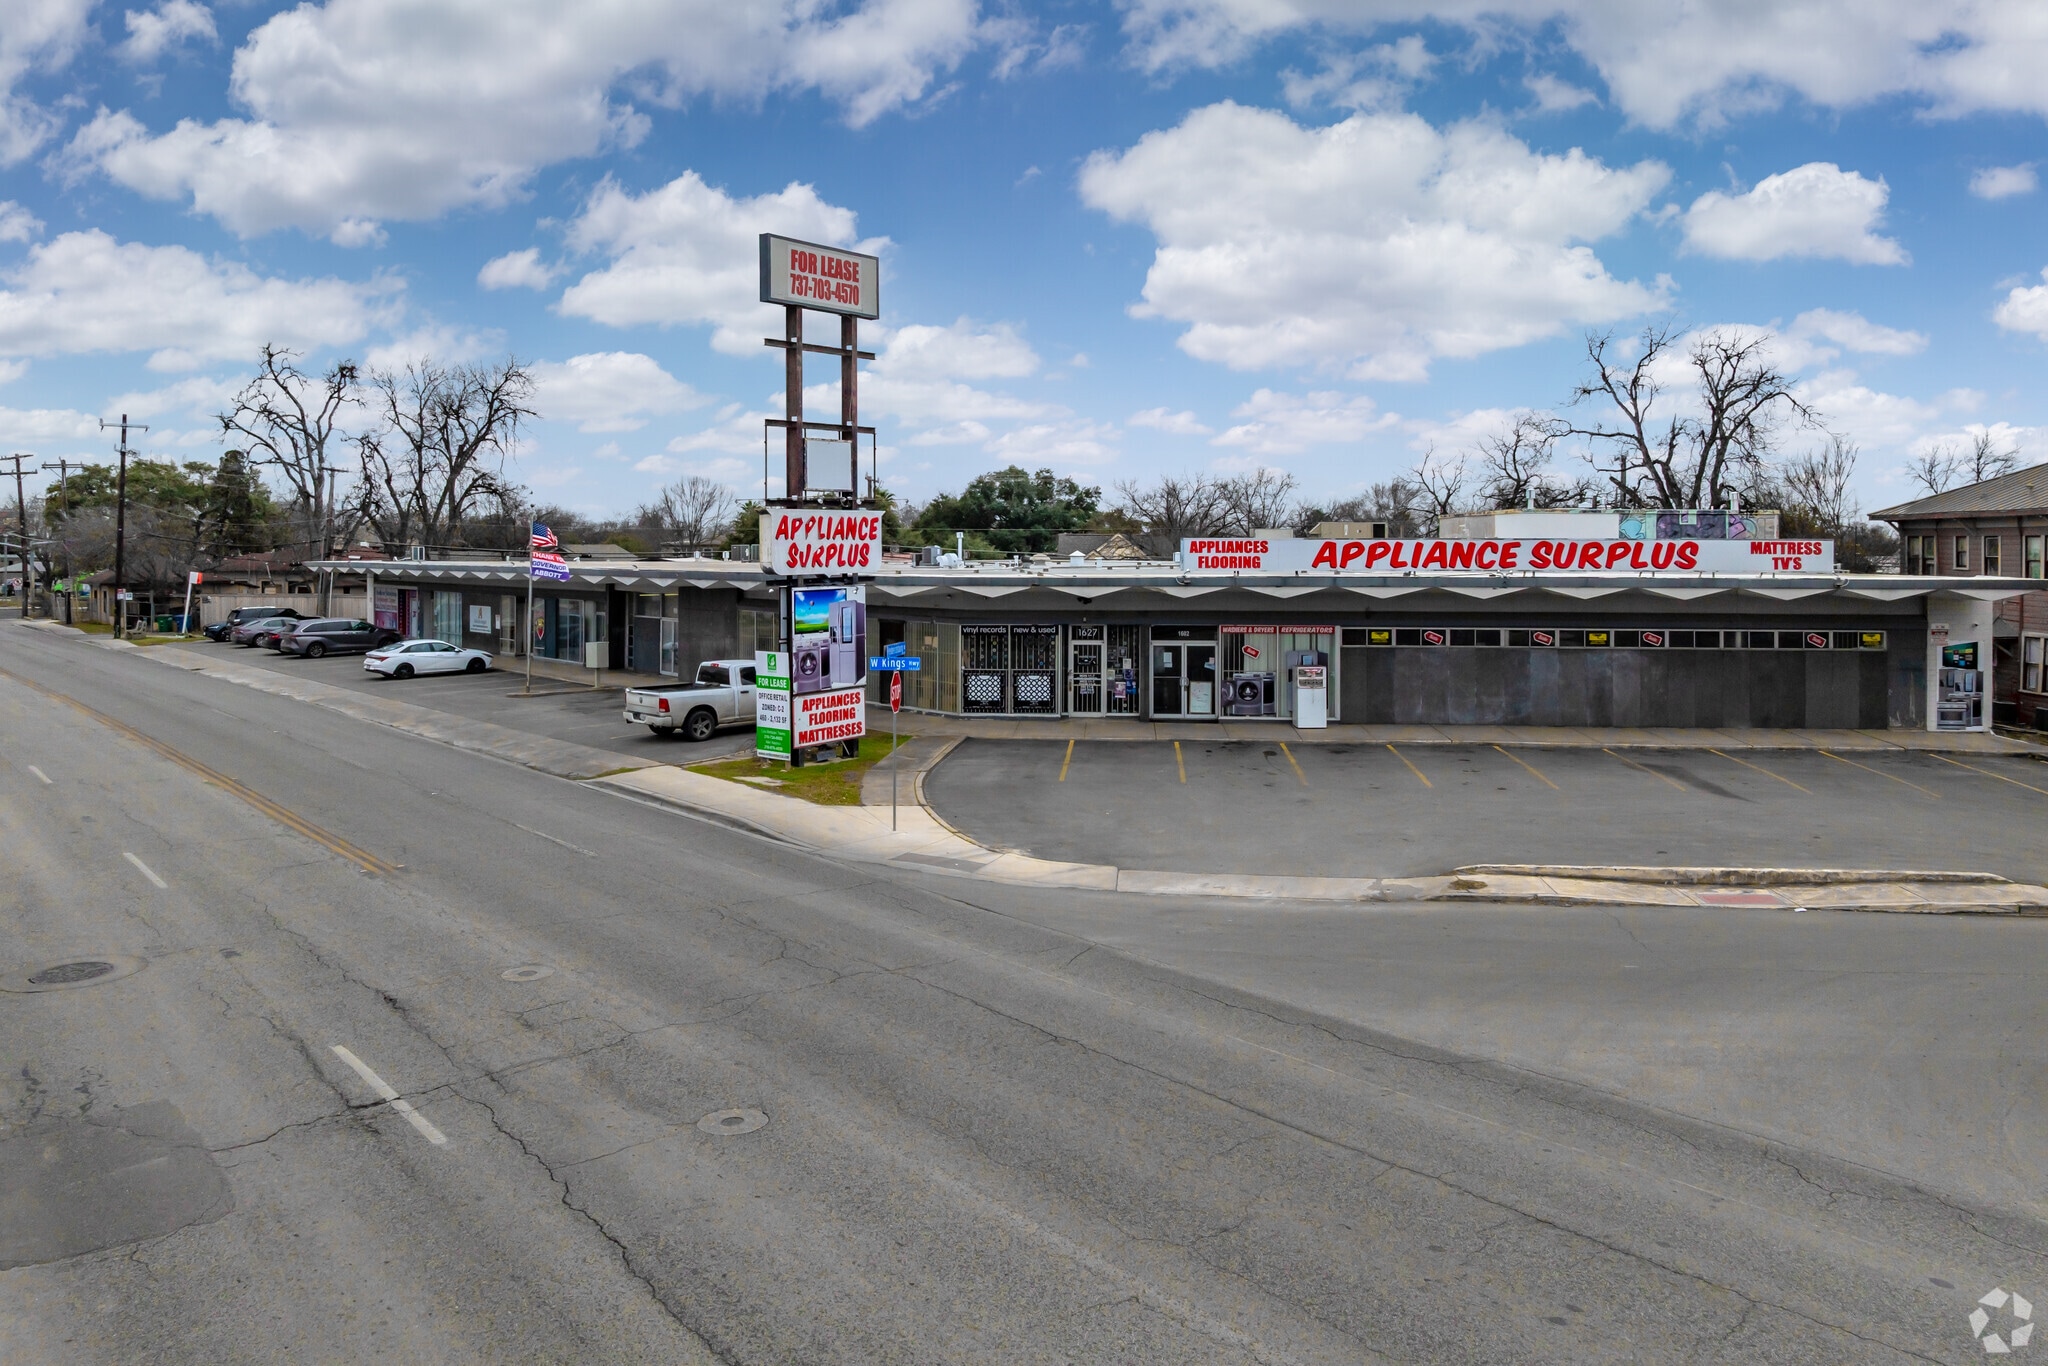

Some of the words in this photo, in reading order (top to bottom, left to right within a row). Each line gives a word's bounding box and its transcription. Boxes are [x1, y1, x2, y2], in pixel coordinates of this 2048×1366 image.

[790, 249, 818, 275] FOR
[820, 255, 860, 283] LEASE
[790, 273, 860, 306] 737-703-4570
[775, 514, 880, 541] APPLIANCE
[1189, 540, 1269, 554] APPLIANCES
[1750, 541, 1823, 556] MATTRESS
[532, 551, 554, 561] THANK
[786, 542, 870, 569] SURPLUS
[1197, 555, 1262, 569] FLOORING
[1311, 540, 1522, 570] APPLIANCE
[1527, 540, 1700, 570] SURPLUS
[532, 560, 567, 571] GOVERNOR
[1772, 556, 1803, 571] TV'S
[534, 569, 563, 579] ABBOTT
[962, 626, 979, 634] vinyl
[979, 626, 1007, 634] records
[1078, 628, 1098, 637] 1627
[870, 658, 879, 668] W
[881, 658, 906, 670] Kings
[908, 660, 920, 668] Hwy
[758, 677, 769, 687] FOR
[769, 678, 787, 689] LEASE
[891, 684, 901, 701] STOP
[802, 692, 861, 713] APPLIANCES
[809, 707, 856, 726] FLOORING
[798, 721, 863, 744] MATTRESSES
